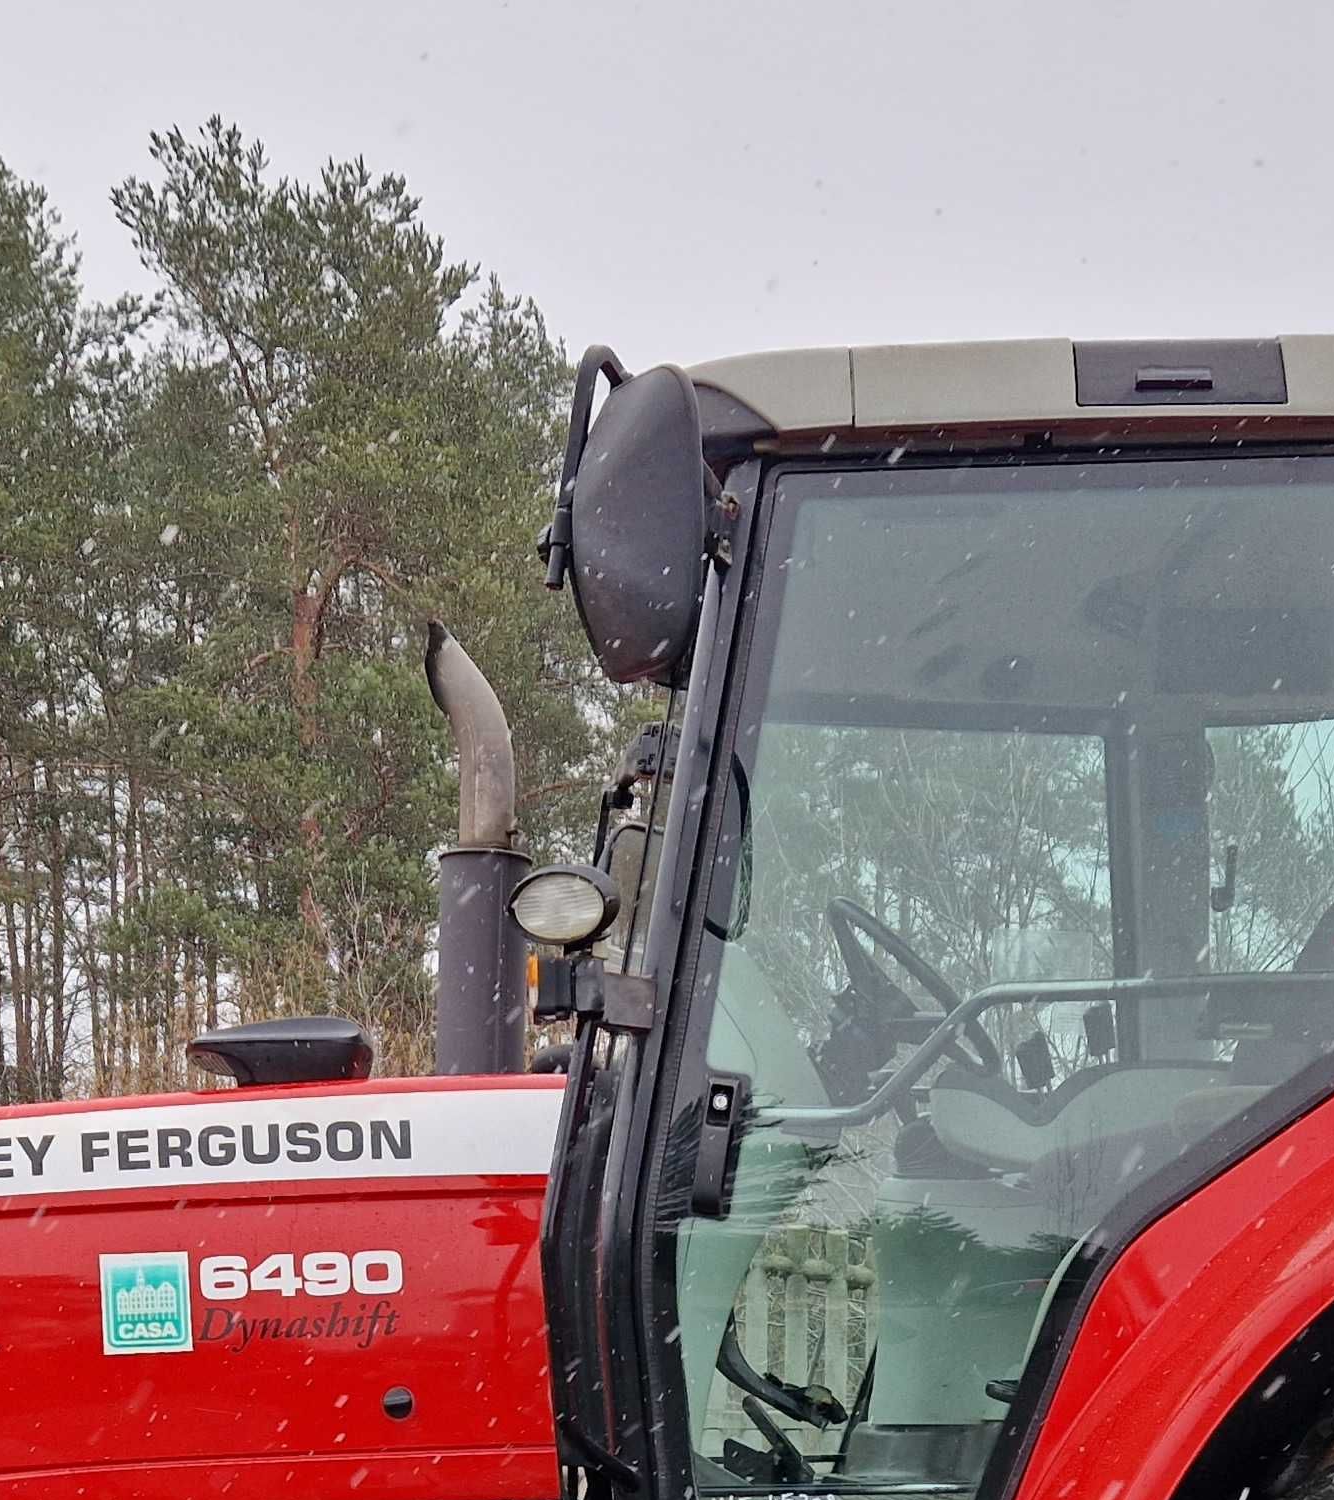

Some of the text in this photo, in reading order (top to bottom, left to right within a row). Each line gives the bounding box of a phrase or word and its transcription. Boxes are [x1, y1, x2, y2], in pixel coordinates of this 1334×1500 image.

[81, 1120, 412, 1173] FERGUSON
[198, 1250, 404, 1300] 6490
[119, 1322, 178, 1339] CASA
[198, 1301, 400, 1352] Dynashift
